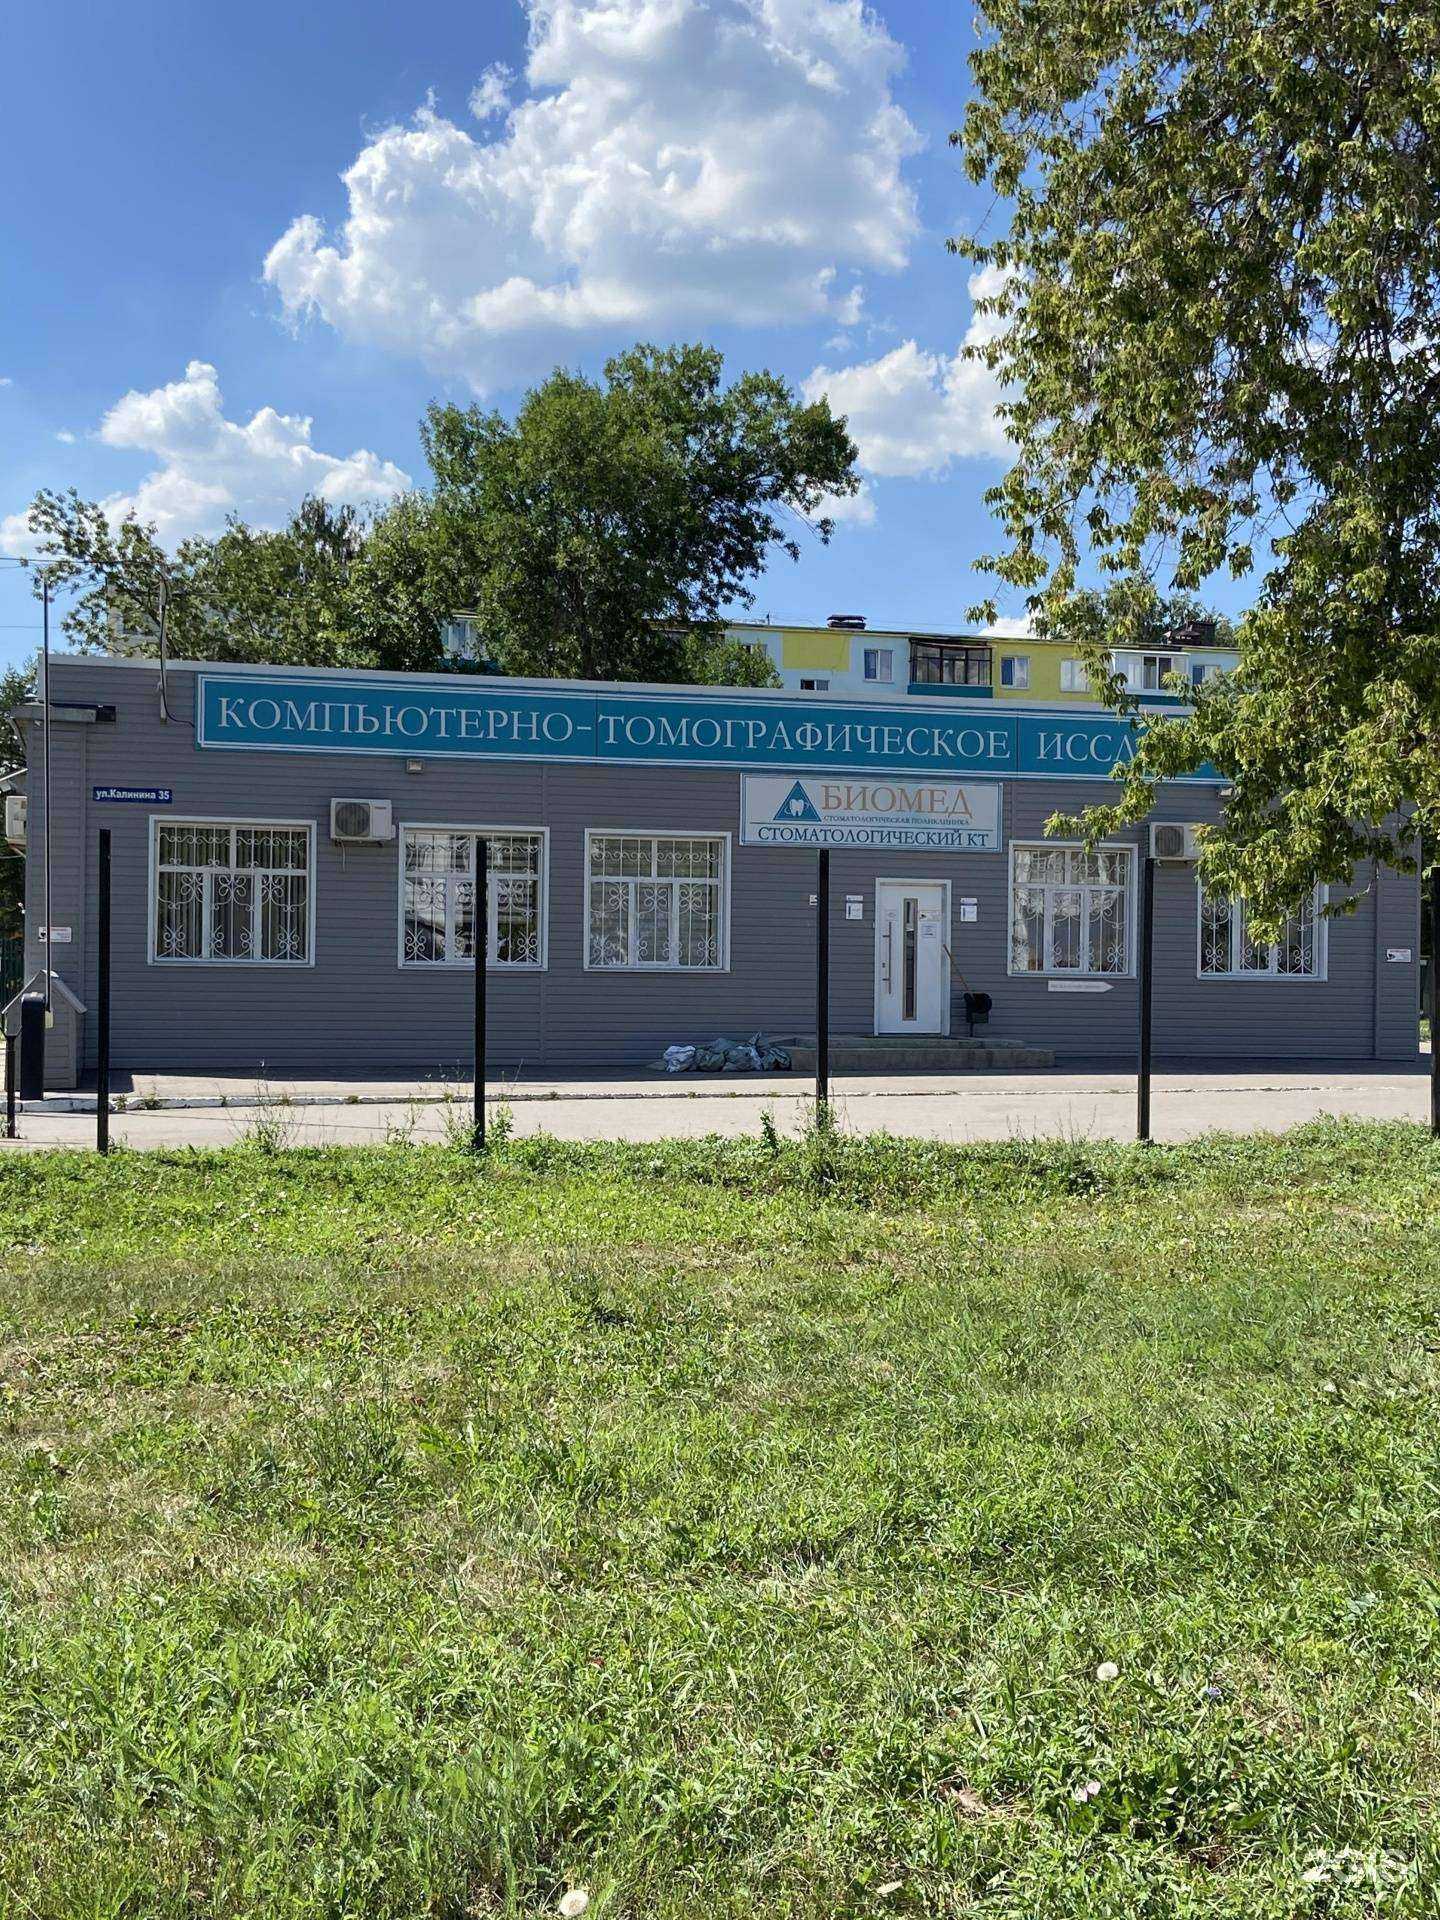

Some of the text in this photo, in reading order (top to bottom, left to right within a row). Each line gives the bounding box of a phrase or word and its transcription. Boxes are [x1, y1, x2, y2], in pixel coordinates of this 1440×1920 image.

[96, 789, 170, 800] ул.Калинина 35
[821, 784, 973, 819] БИОМЕД
[758, 827, 989, 847] СТОМАТОЛОГИЧЕСКИЙ КТ
